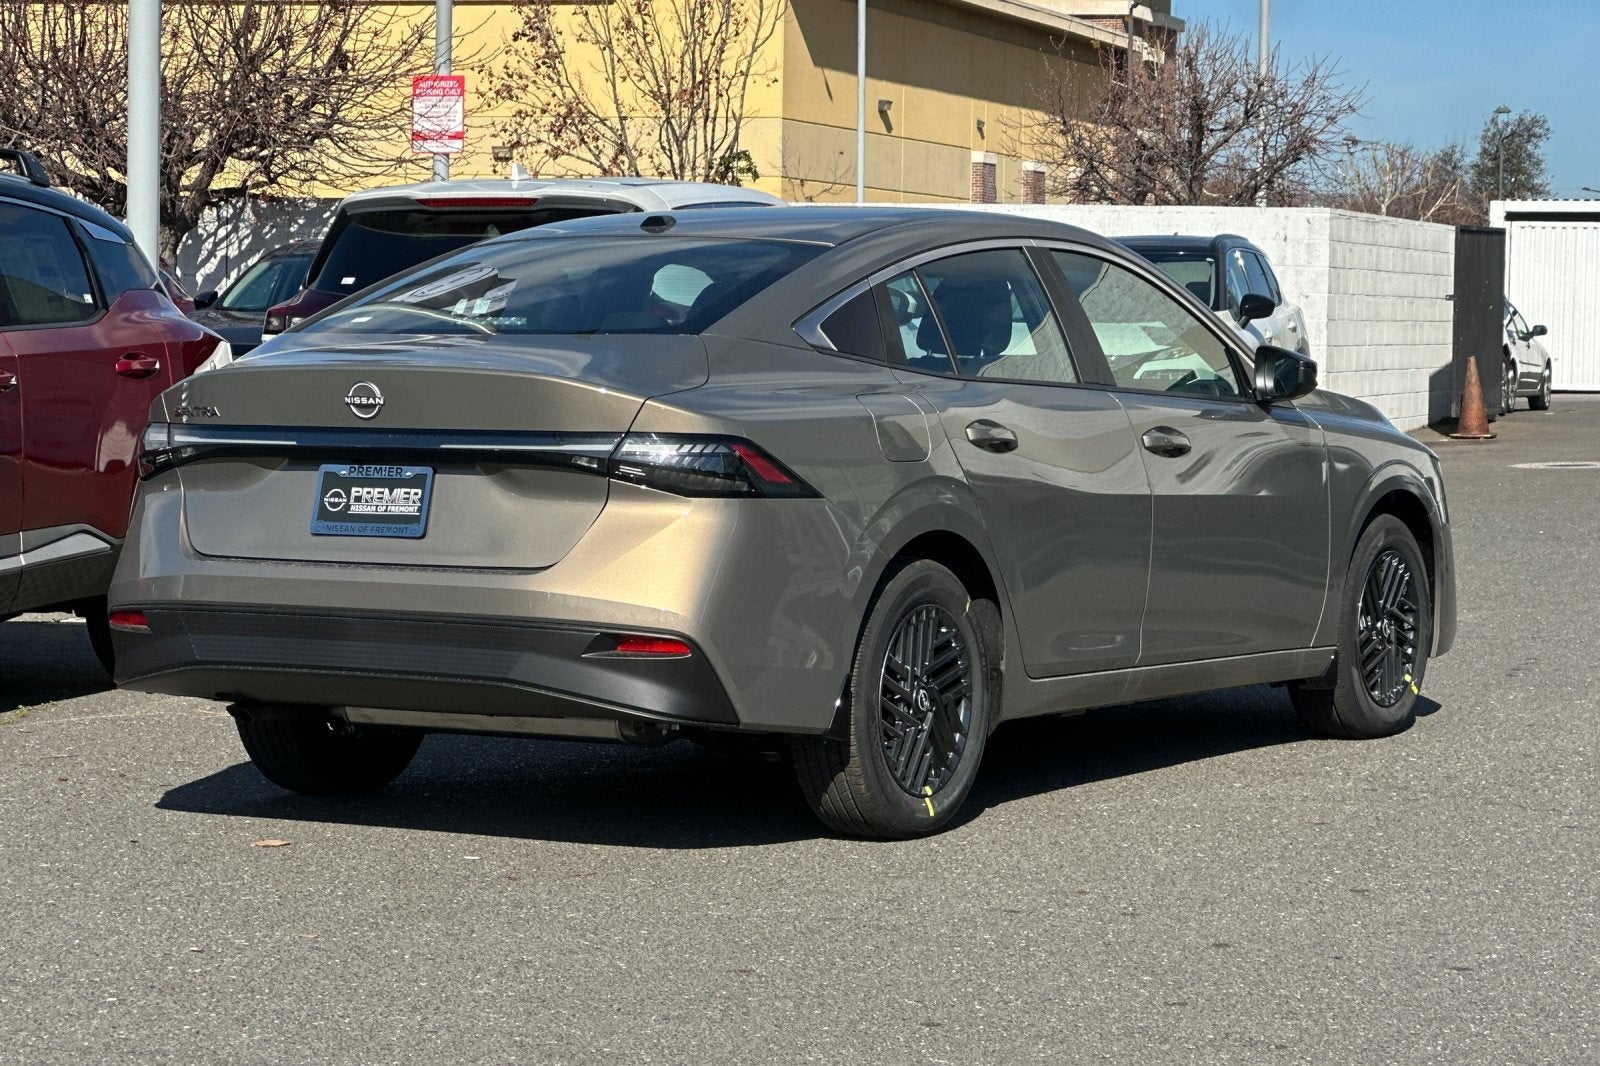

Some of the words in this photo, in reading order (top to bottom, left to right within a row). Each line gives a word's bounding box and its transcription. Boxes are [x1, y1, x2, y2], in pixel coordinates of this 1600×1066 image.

[344, 396, 384, 404] NISSAN
[348, 466, 403, 477] PREMIER
[349, 487, 422, 505] PREMIER
[387, 505, 419, 513] FREMONT
[325, 525, 356, 533] NISSAN
[370, 526, 409, 534] FREMONT
